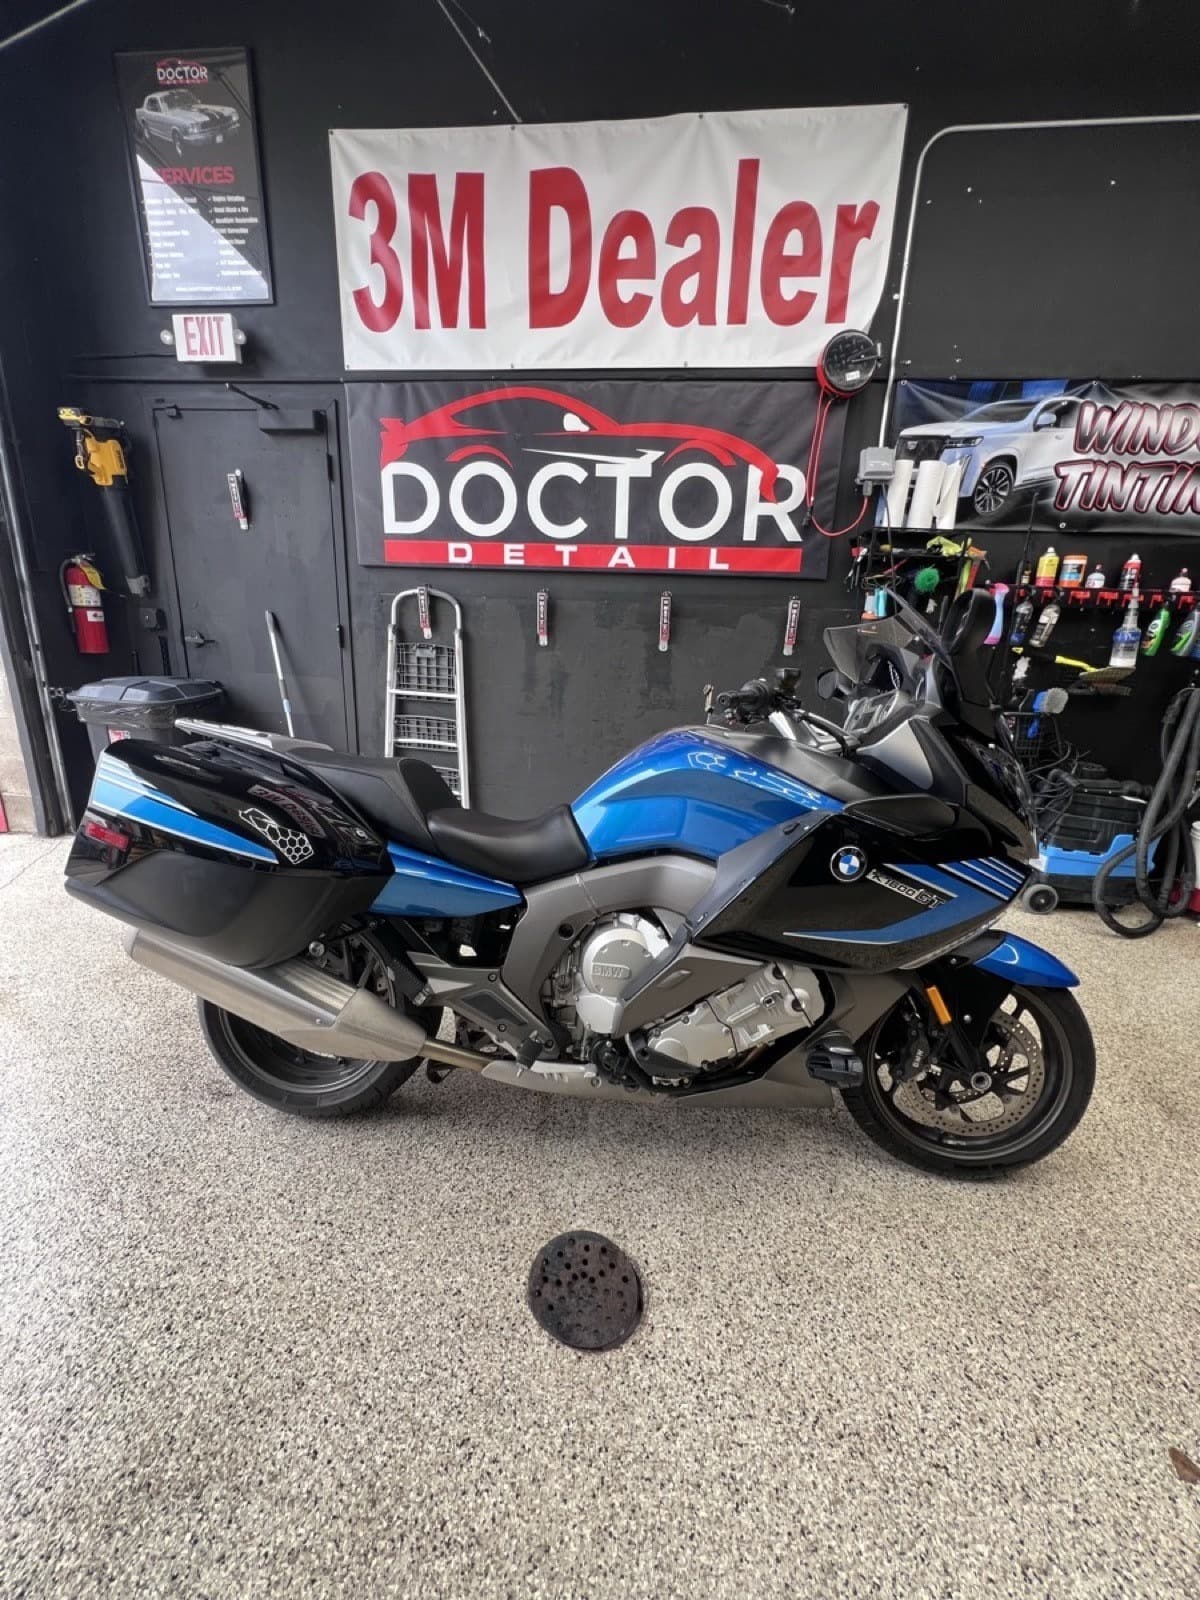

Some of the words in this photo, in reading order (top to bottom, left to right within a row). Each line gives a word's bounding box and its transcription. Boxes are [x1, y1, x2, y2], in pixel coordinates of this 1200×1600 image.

[156, 66, 208, 81] DOCTOR
[348, 170, 487, 333] 3M
[528, 158, 881, 329] Dealer
[183, 316, 225, 356] EXIT
[1073, 400, 1200, 456] WIND
[380, 460, 807, 543] DOCTOR
[447, 542, 730, 571] DETAIL
[592, 965, 624, 978] BMW
